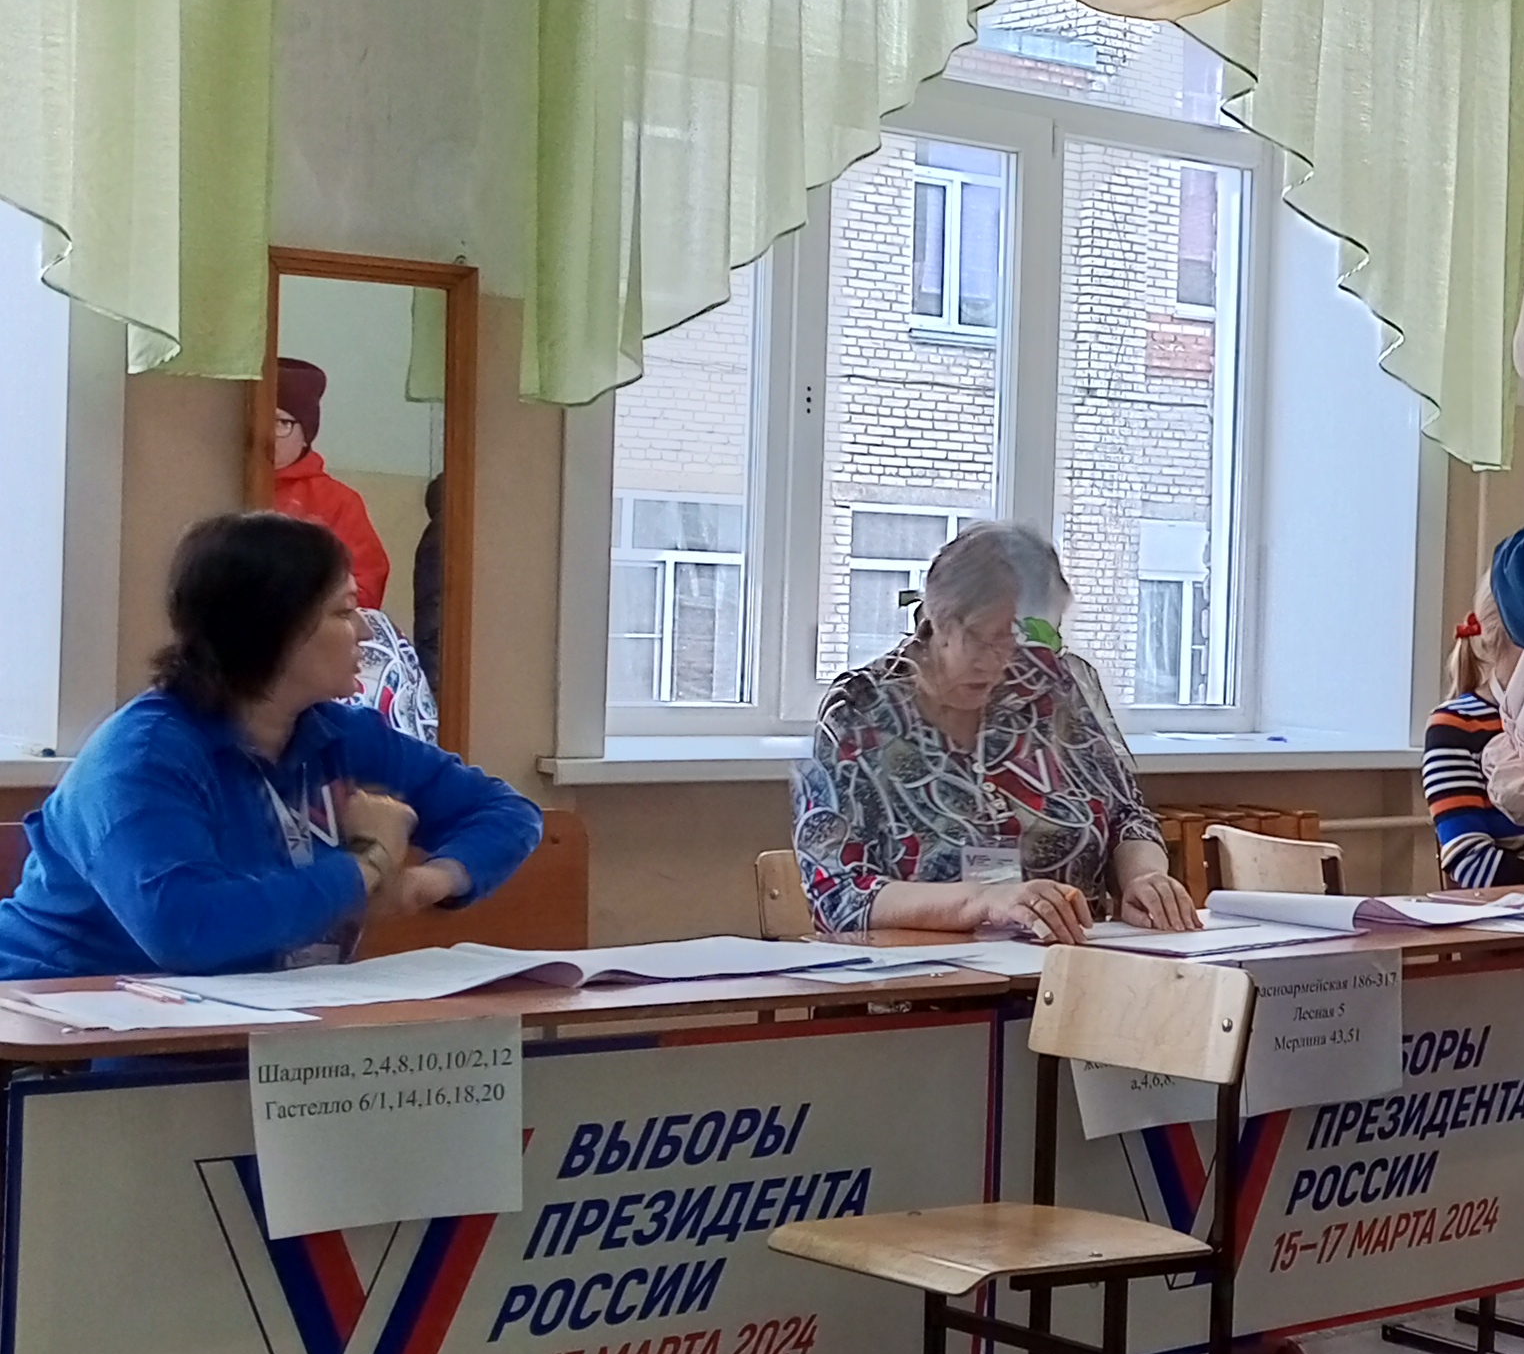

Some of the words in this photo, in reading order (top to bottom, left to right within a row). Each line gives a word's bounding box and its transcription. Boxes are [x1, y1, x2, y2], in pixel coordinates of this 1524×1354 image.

[1257, 978, 1349, 998] асноармейская
[1352, 971, 1398, 990] 186-317
[1292, 1006, 1335, 1022] Лесная
[1337, 1002, 1346, 1017] 5
[257, 1062, 356, 1085] Шадрина,
[361, 1047, 513, 1077] 2,4,8,10,10/2,12
[1273, 1033, 1327, 1053] Мерлина
[1329, 1027, 1361, 1045] 43,51
[1402, 1024, 1491, 1077] БОРЫ
[265, 1099, 353, 1120] Гастелло
[358, 1083, 505, 1112] 6/1,14,16,18,20
[556, 1102, 811, 1180] ВЫБОРЫ
[1284, 1150, 1440, 1216] РОССИИ
[522, 1167, 872, 1260] ПРЕЗИДЕНТА
[1346, 1207, 1437, 1259] МАРТА
[1438, 1196, 1500, 1242] 2024
[486, 1257, 727, 1343] РОССИИ
